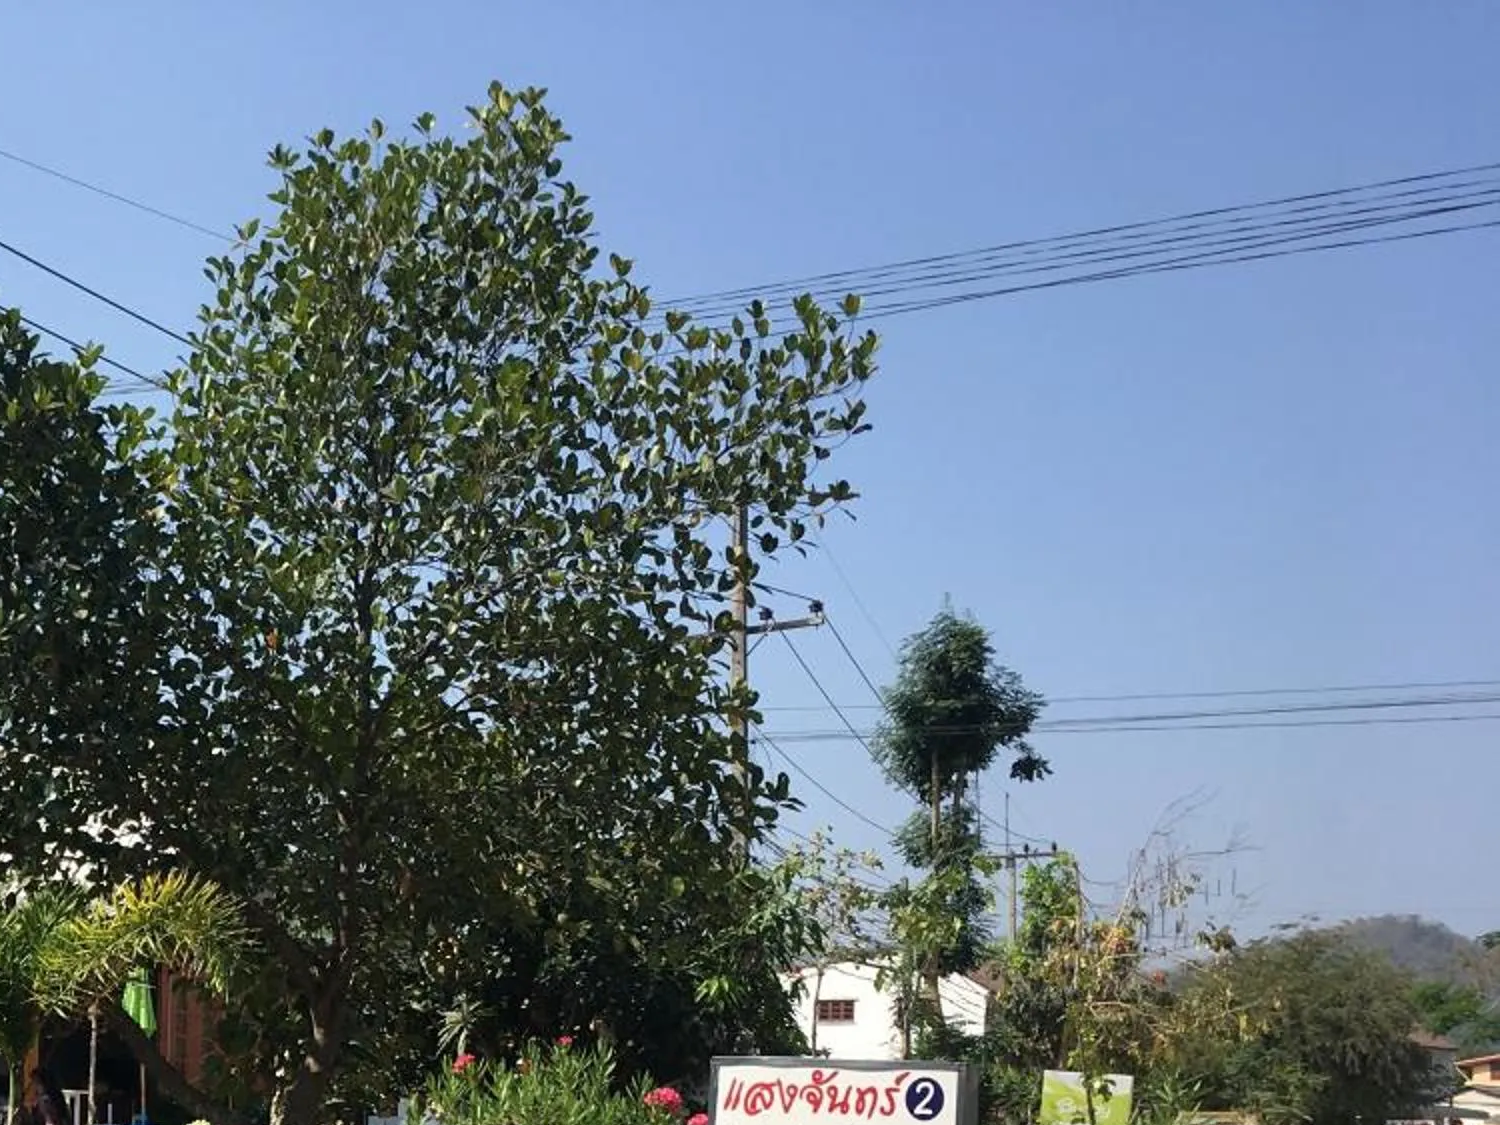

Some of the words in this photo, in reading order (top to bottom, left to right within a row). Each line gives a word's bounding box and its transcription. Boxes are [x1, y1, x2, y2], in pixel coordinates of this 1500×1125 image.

[723, 1069, 910, 1120] แสงจันทร์
[913, 1082, 934, 1116] 2
